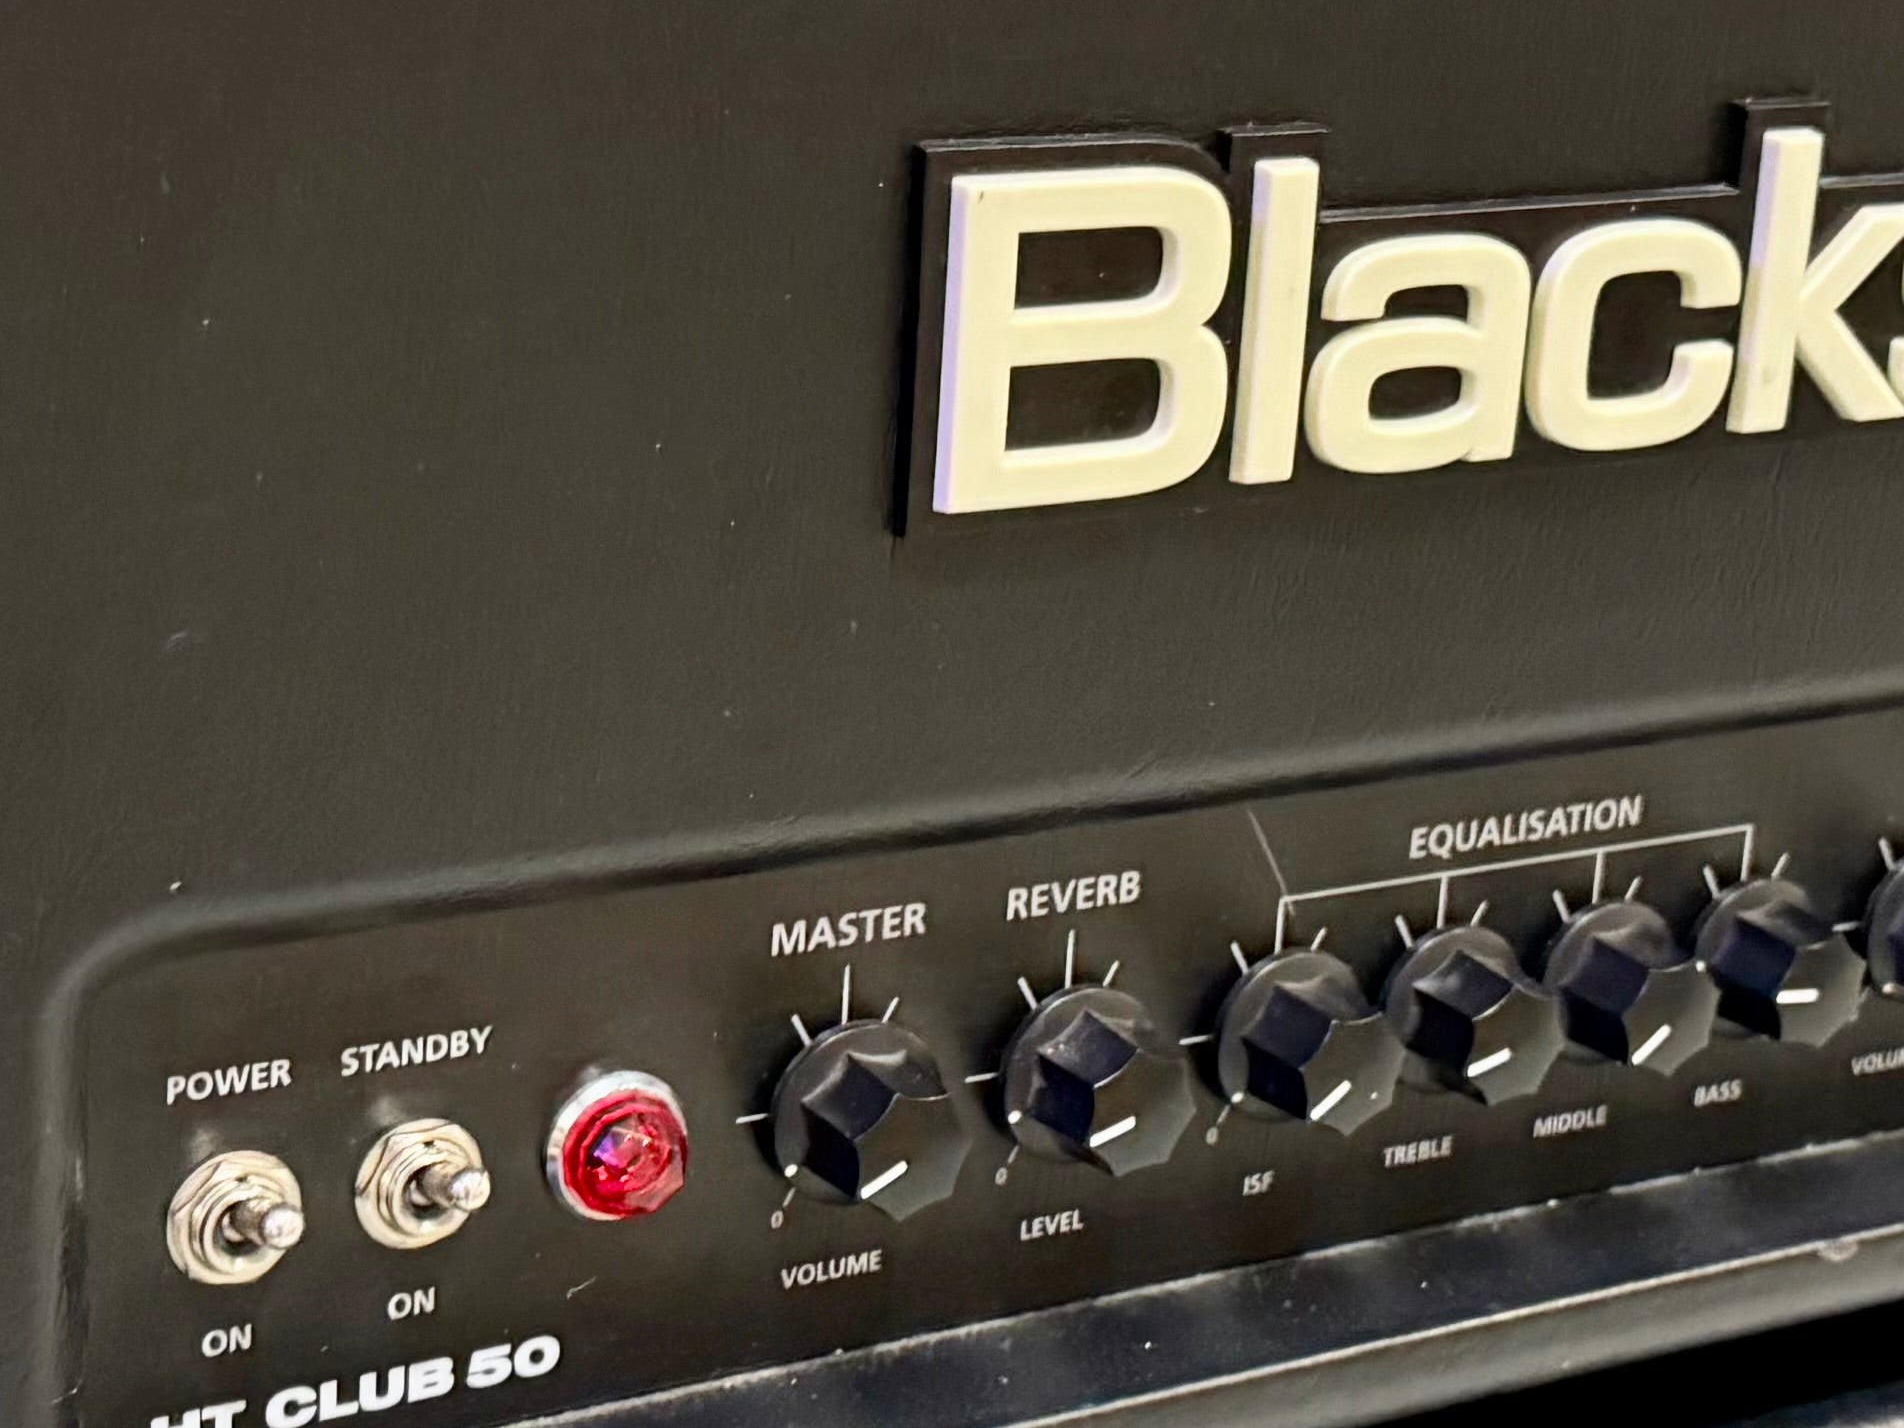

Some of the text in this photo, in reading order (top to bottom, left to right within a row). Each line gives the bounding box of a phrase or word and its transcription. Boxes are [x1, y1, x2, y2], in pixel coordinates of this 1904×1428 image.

[1408, 794, 1644, 860] EQUALISATION
[1005, 870, 1142, 921] REVERB
[770, 902, 928, 958] MASTER
[340, 1024, 494, 1077] STANDBY
[165, 1058, 293, 1105] POWER
[1693, 1078, 1744, 1106] BASS
[1532, 1105, 1608, 1139] MIDDLE
[1383, 1135, 1454, 1168] TREBLE
[1242, 1170, 1275, 1197] ISF
[770, 1210, 784, 1230] 0
[1019, 1208, 1085, 1242] LEVEL
[780, 1248, 883, 1290] VOLUME
[386, 1286, 436, 1321] ON
[201, 1323, 252, 1358] ON
[465, 1334, 562, 1390] 50
